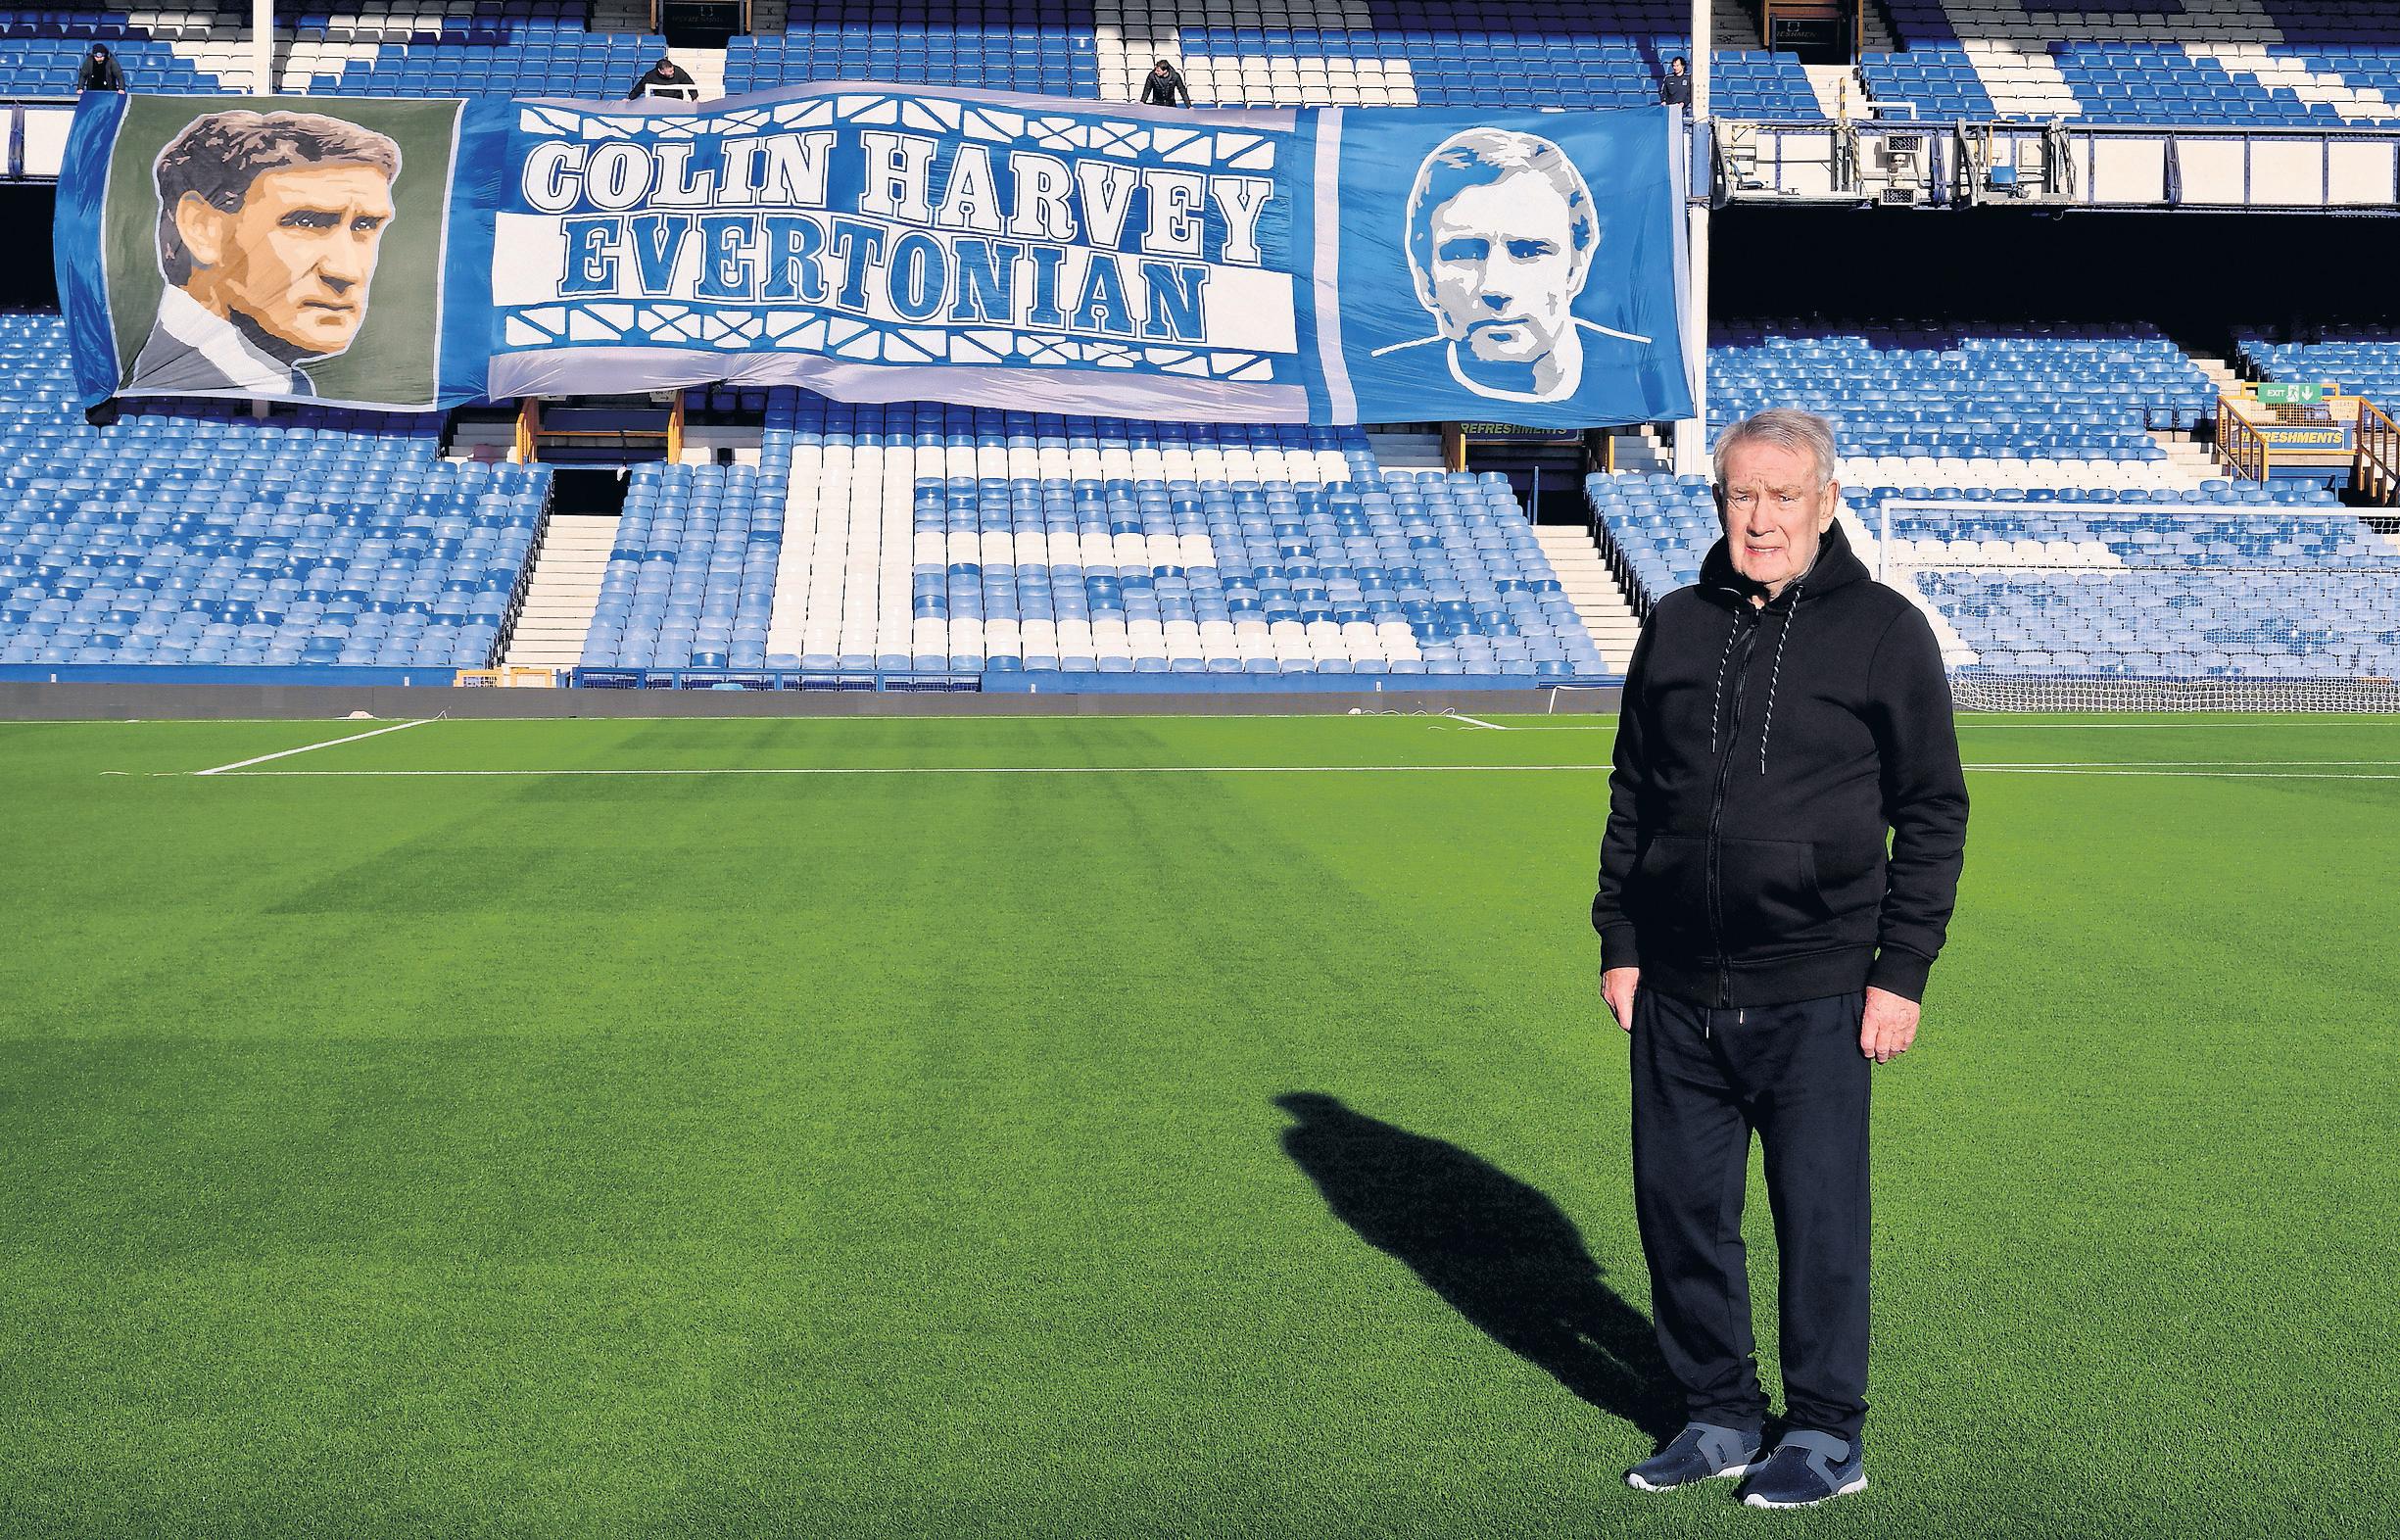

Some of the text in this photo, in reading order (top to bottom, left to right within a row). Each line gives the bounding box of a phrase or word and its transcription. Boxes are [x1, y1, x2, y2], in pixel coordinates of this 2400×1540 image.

[521, 129, 1274, 266] COLIN HARVEY
[556, 210, 1211, 344] EVERTONIAN
